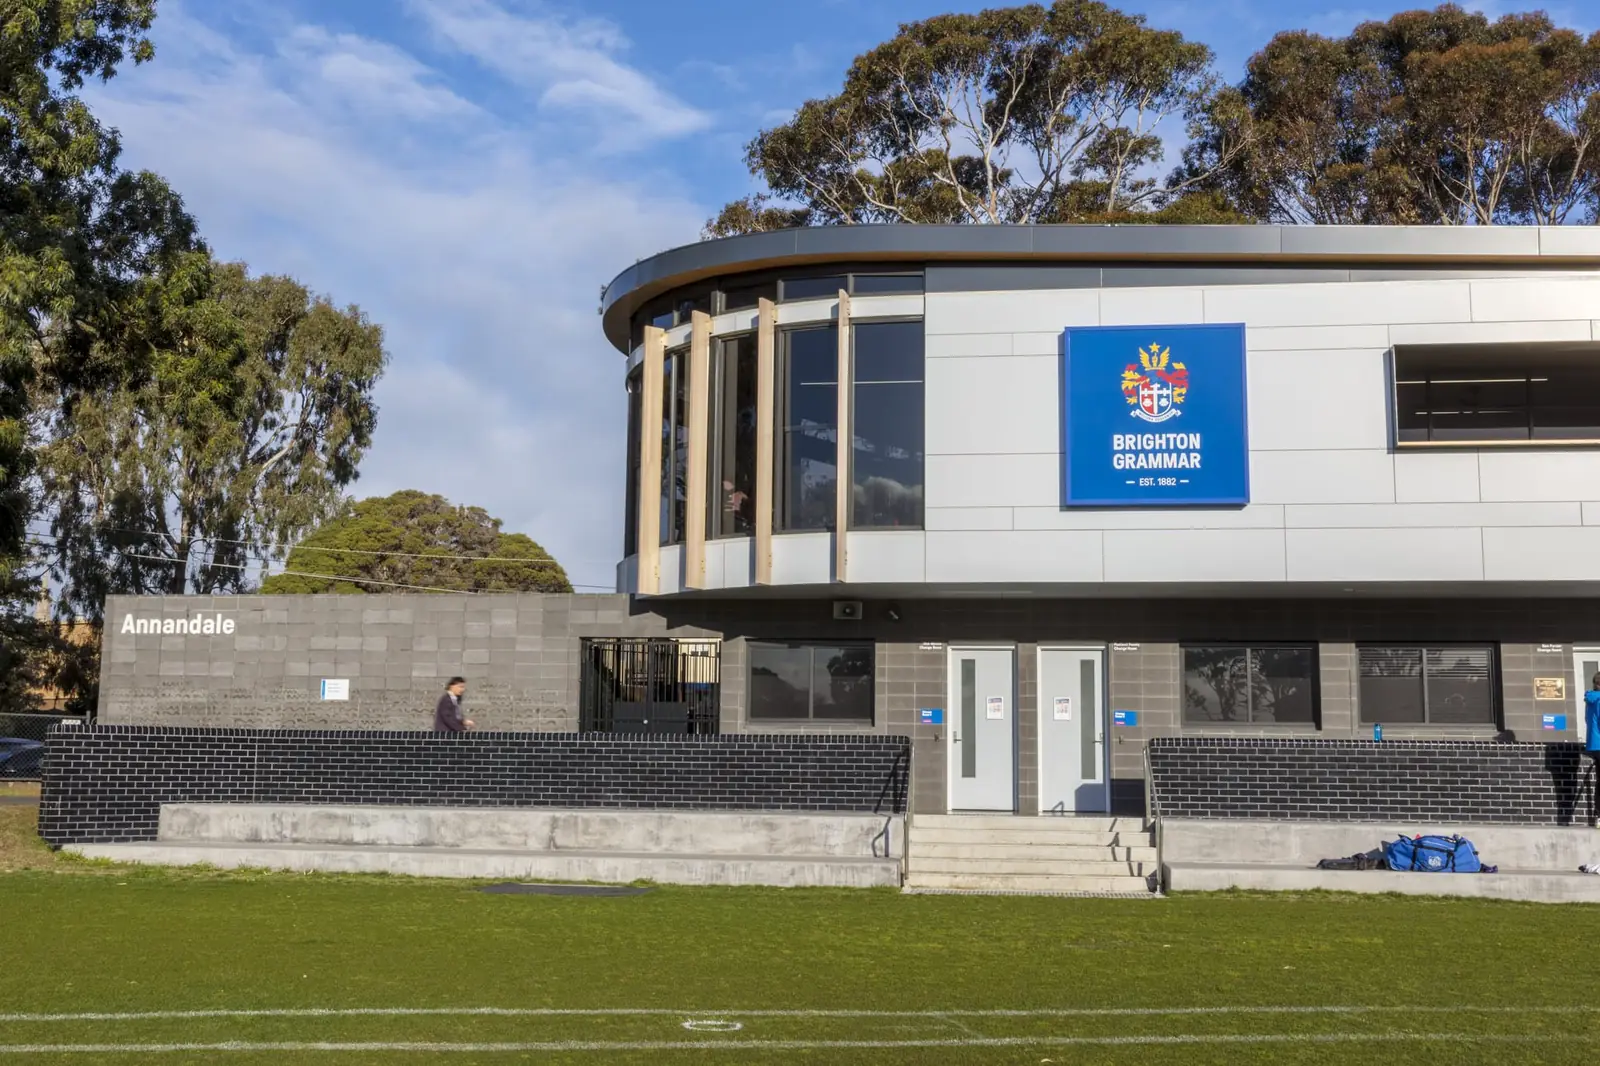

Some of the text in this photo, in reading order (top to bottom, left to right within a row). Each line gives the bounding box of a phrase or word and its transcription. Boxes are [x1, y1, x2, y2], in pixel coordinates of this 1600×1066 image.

[1113, 433, 1201, 450] BRIGHTON
[1113, 453, 1201, 469] GRAMMAR
[1139, 477, 1177, 486] EST. 1882
[121, 613, 235, 635] Annandale
